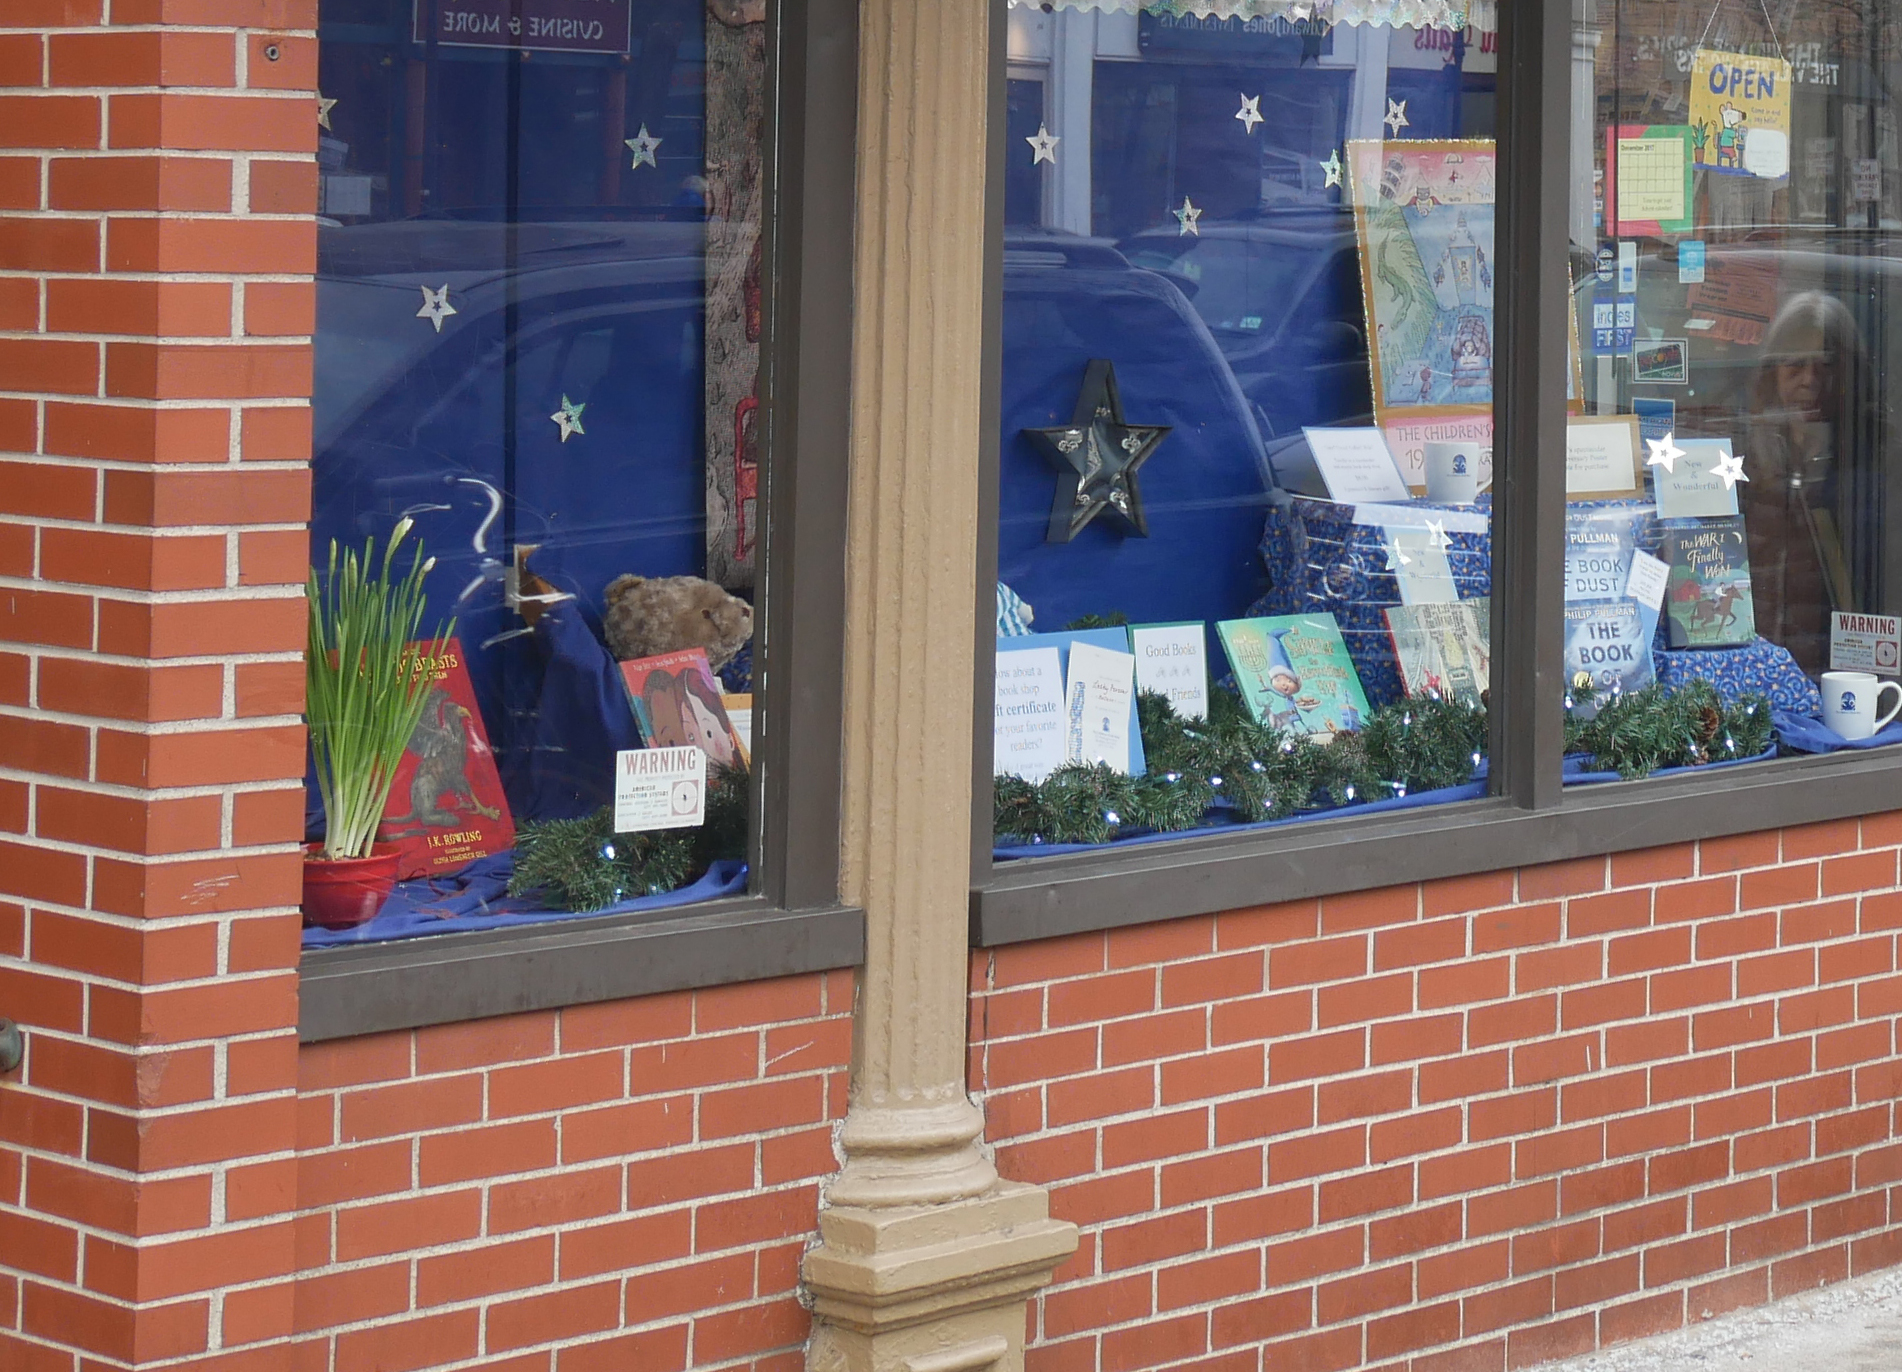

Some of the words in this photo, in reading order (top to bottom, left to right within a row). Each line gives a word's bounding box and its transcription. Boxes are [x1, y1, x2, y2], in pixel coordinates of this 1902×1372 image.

[1709, 62, 1775, 101] OPEN
[1396, 427, 1421, 442] THE
[1424, 422, 1493, 441] CHILDREN'S
[1405, 448, 1425, 471] 19
[1672, 481, 1719, 491] Wonderful
[1570, 531, 1620, 545] PULLMAN
[1694, 532, 1718, 549] WAR
[1577, 558, 1625, 575] BOOK
[1686, 547, 1725, 573] Finally
[1576, 577, 1620, 593] DUST
[1594, 606, 1636, 619] PULLMAN
[1586, 621, 1621, 640] THE
[1838, 614, 1896, 636] WARNING
[1145, 643, 1171, 658] Good
[1172, 642, 1197, 657] Books
[1579, 643, 1635, 665] BOOK
[994, 666, 1011, 679] ow
[1013, 665, 1035, 677] about
[1036, 668, 1042, 677] a
[1019, 681, 1041, 697] shop
[1171, 687, 1201, 702] Friends
[1005, 699, 1057, 716] certificate
[1025, 719, 1057, 734] favorite
[1010, 738, 1043, 753] readers?
[625, 748, 697, 776] WARNING
[445, 829, 483, 846] ROWLING
